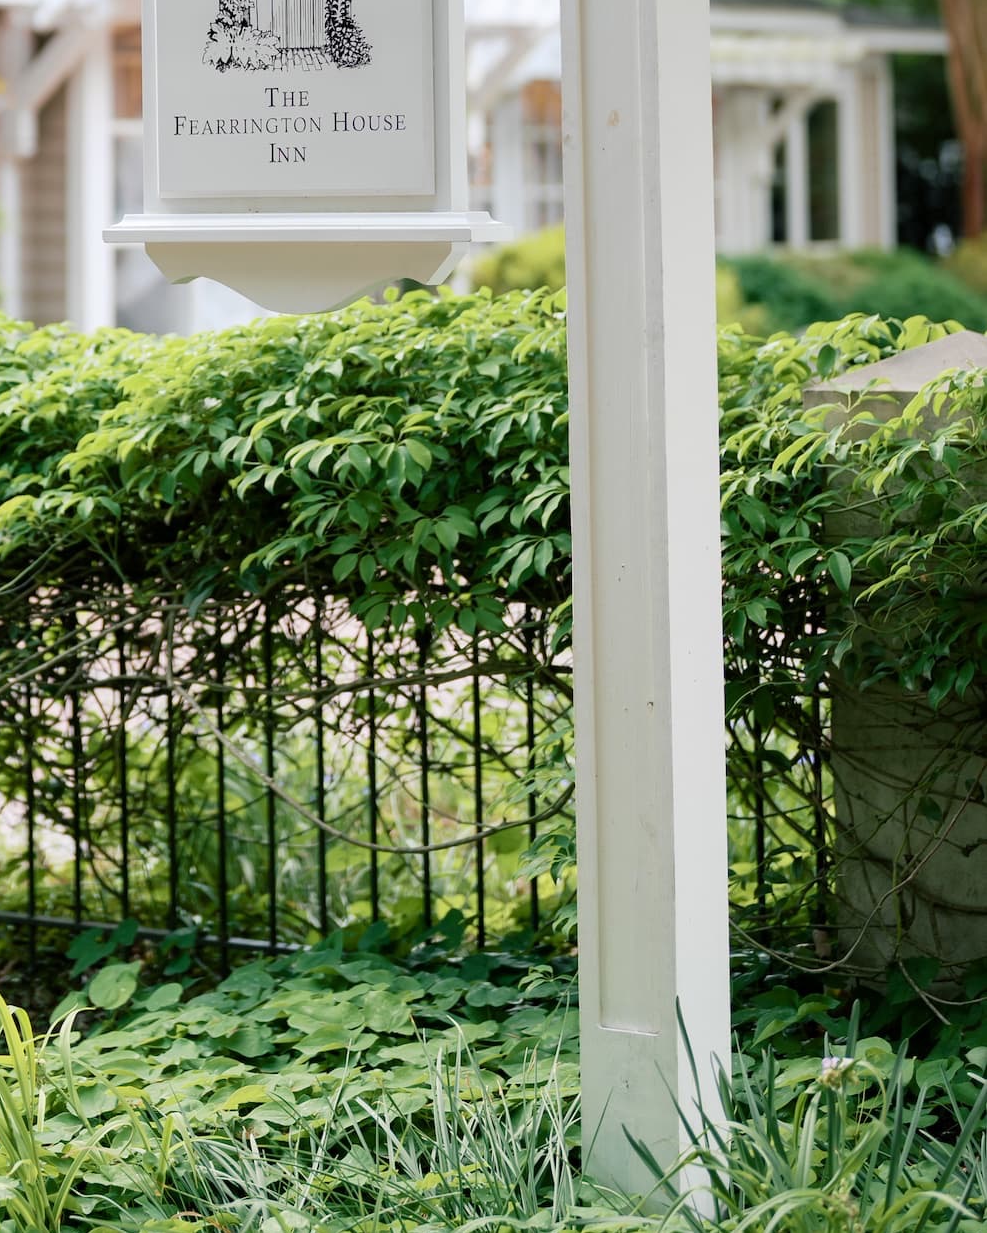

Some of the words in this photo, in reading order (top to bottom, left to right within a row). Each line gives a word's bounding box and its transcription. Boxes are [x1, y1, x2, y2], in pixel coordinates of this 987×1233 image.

[264, 87, 310, 108] THE
[174, 116, 322, 137] FEARRINGTON
[333, 111, 407, 133] HOUSE
[269, 143, 307, 164] INN
